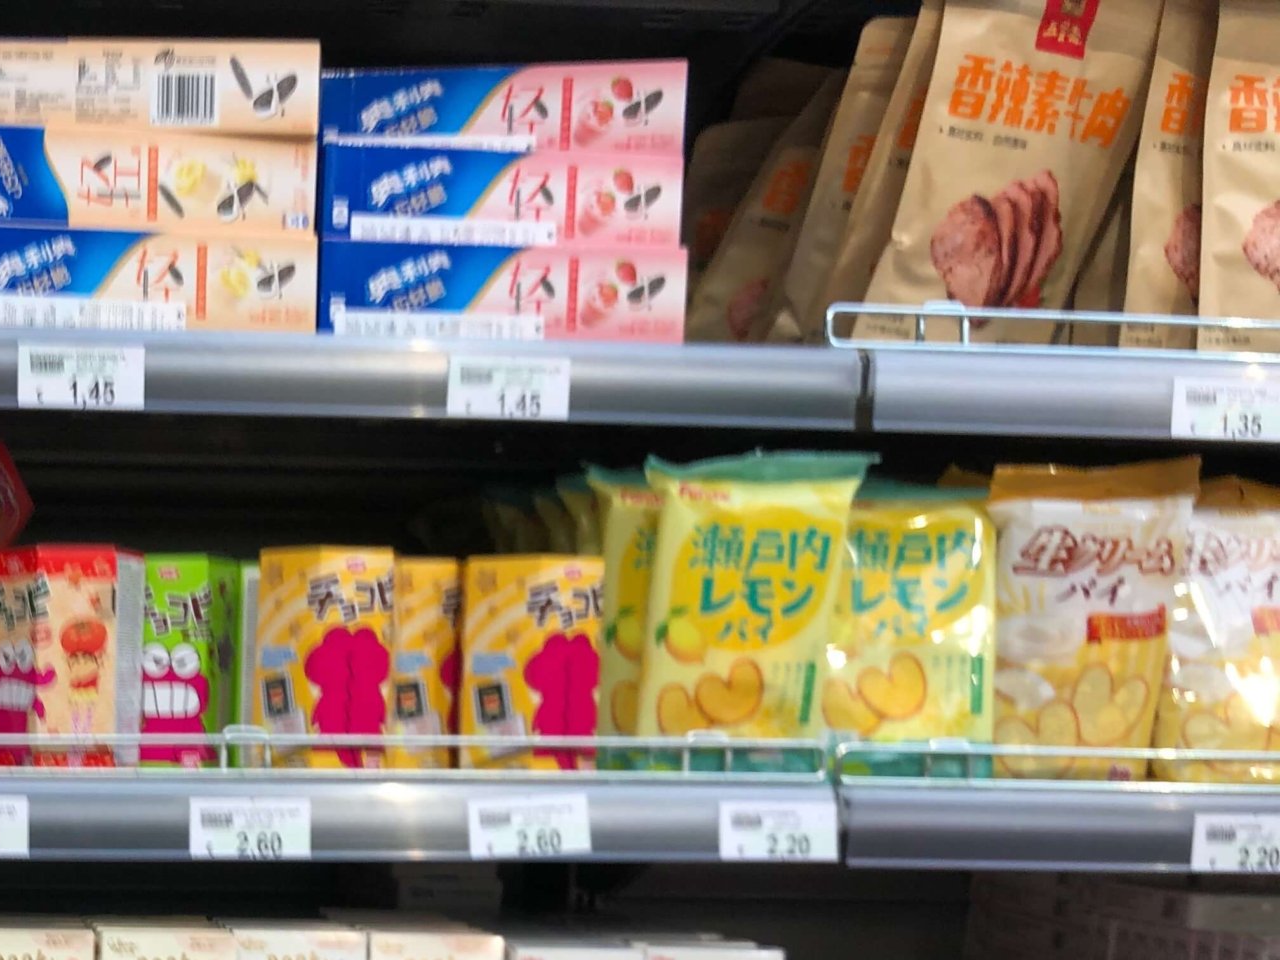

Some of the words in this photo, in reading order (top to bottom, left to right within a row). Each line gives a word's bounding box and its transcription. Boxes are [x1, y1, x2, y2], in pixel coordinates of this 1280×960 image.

[69, 379, 116, 411] 1,45
[1219, 412, 1263, 441] 1,35
[700, 577, 814, 616] レモン
[236, 830, 282, 860] 2,60
[517, 828, 562, 855] 2,60
[766, 833, 811, 861] 2,20
